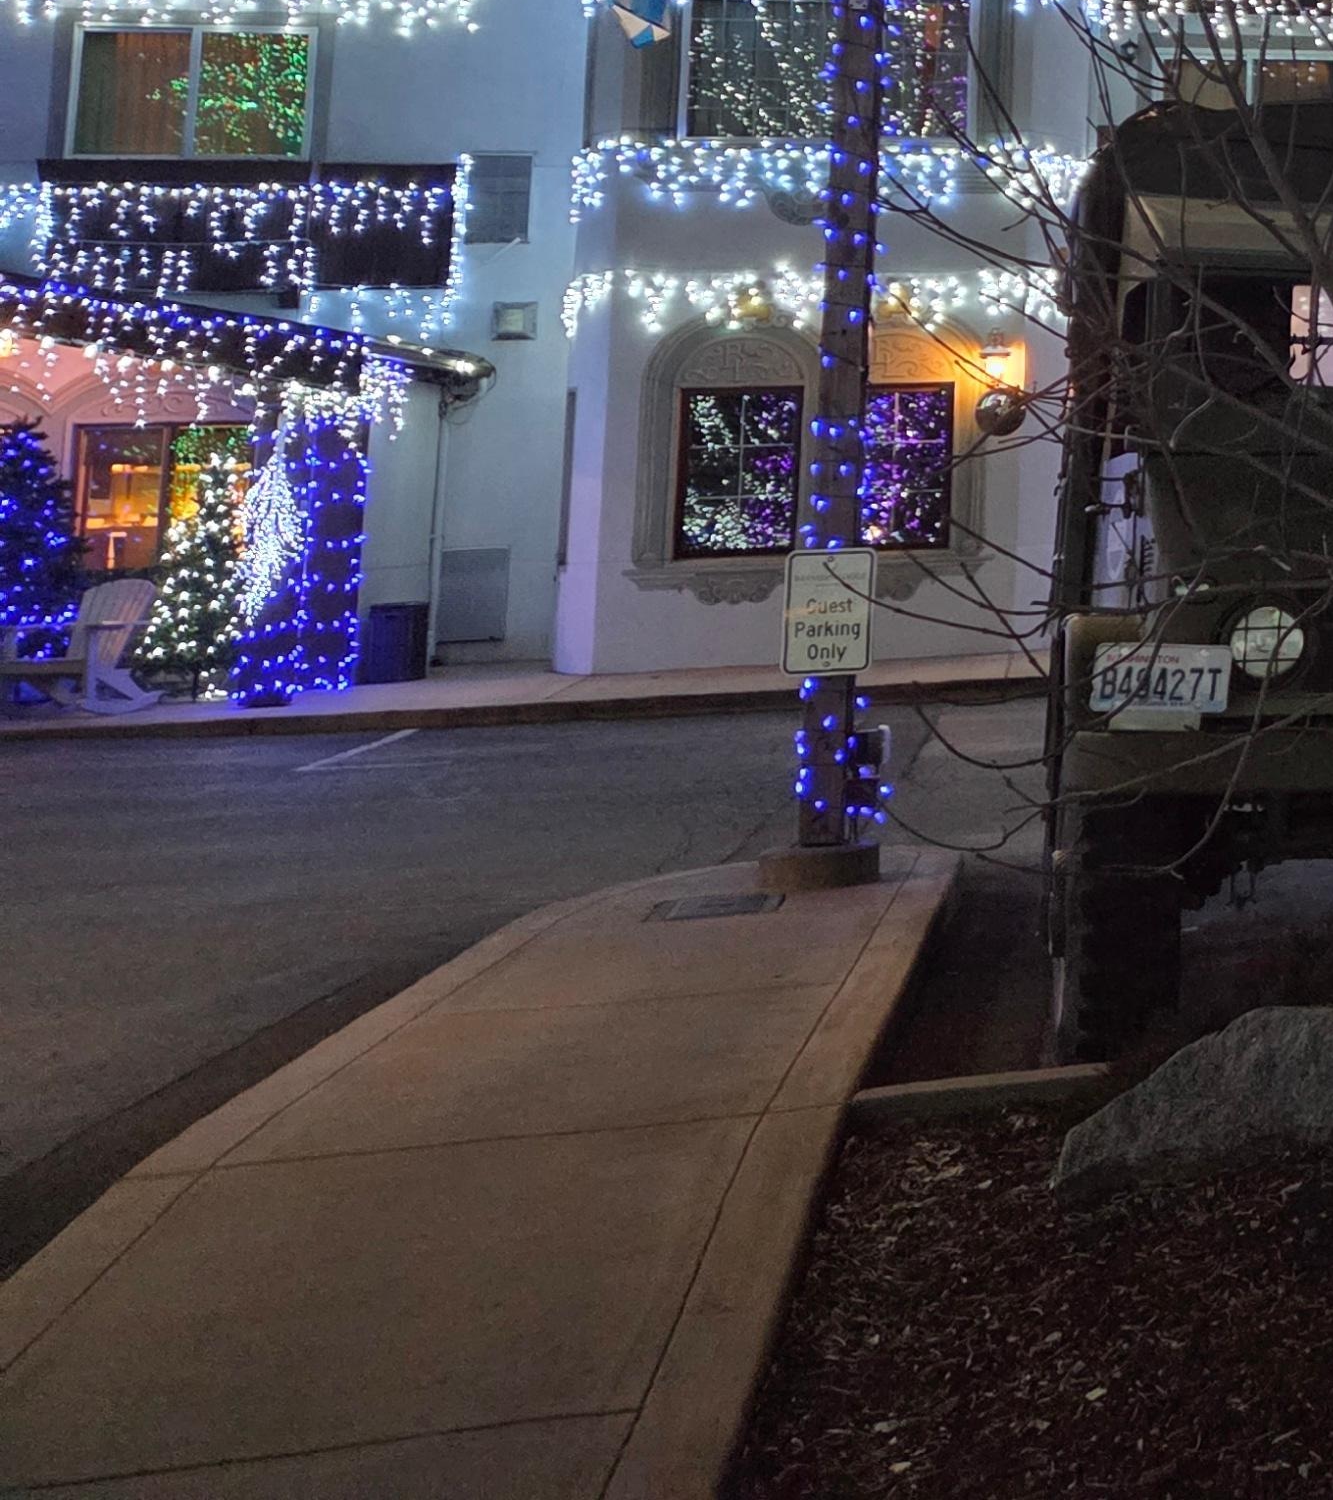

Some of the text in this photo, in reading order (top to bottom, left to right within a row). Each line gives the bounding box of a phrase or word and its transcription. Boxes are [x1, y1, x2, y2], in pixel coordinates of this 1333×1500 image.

[806, 598, 853, 615] Guest
[794, 621, 860, 640] Parking
[807, 643, 847, 662] Only
[1106, 652, 1180, 664] WSHINTON
